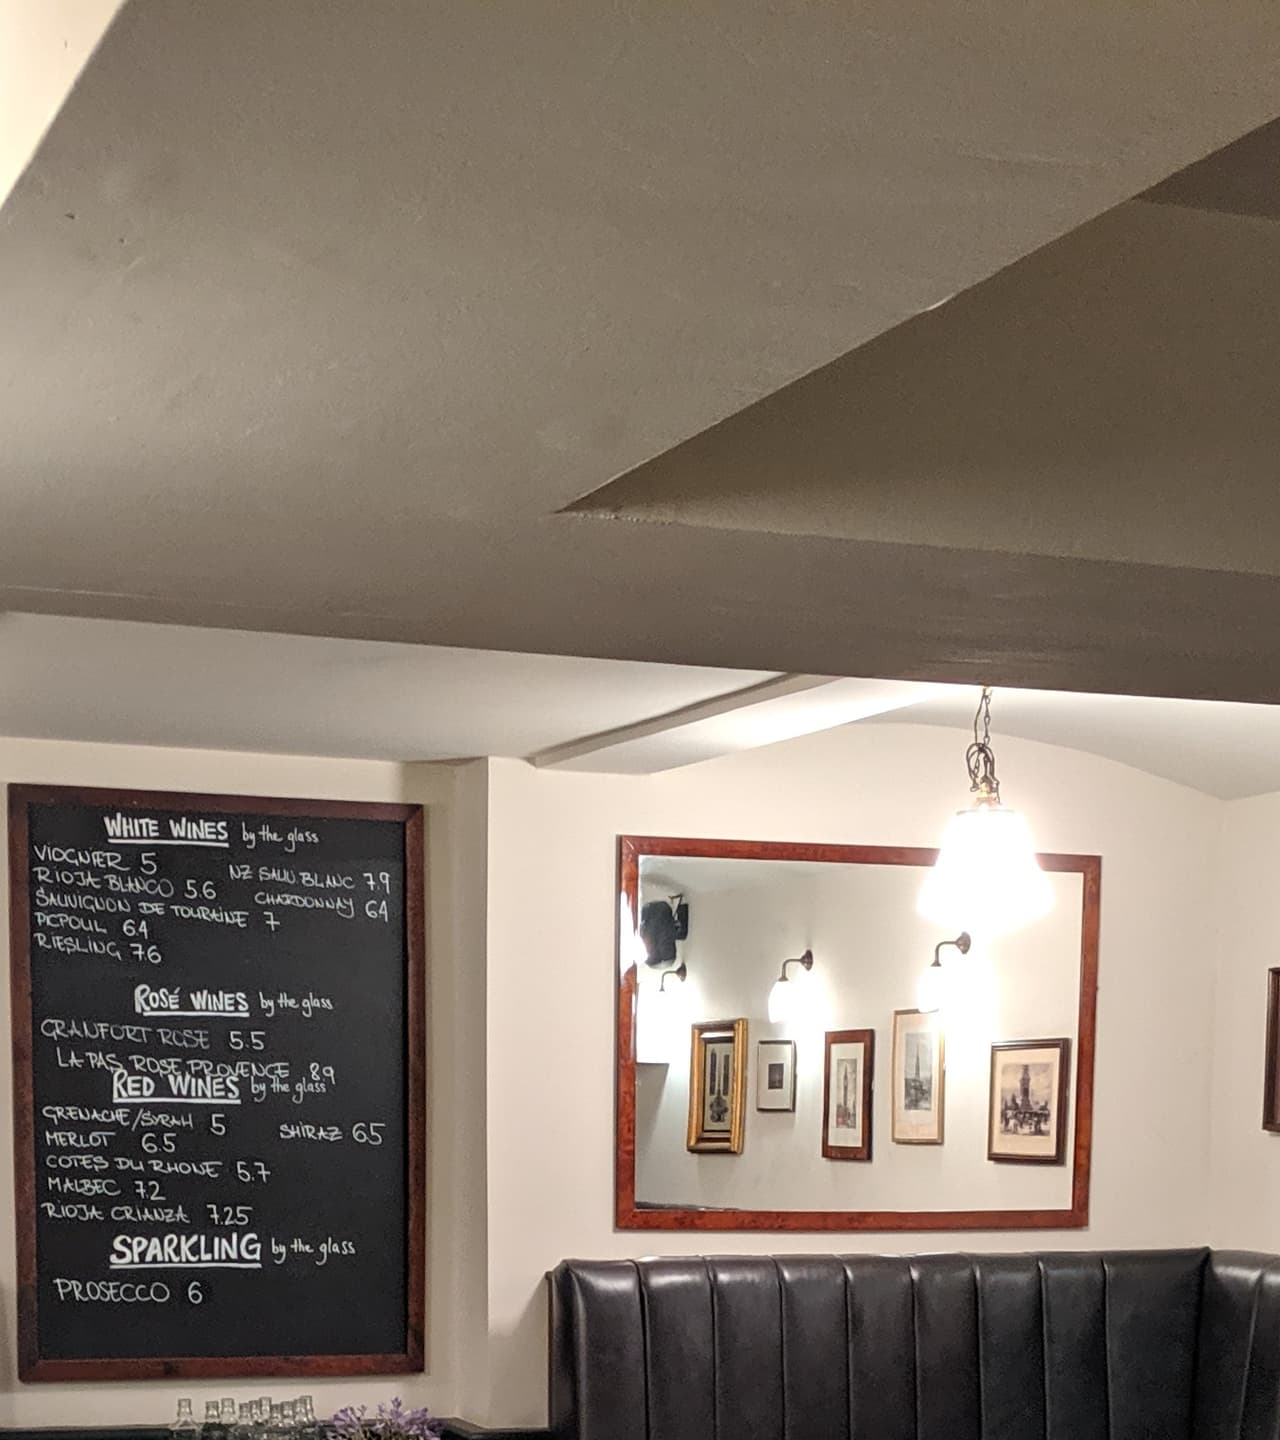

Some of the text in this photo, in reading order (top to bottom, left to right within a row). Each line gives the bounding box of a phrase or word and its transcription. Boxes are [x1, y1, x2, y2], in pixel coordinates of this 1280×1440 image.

[104, 813, 319, 852] WHITE WINES by the glass
[140, 852, 157, 875] 5
[32, 866, 217, 900] RIOJA BLANCO 5.6
[229, 864, 253, 880] NZ
[299, 872, 355, 889] BLANC
[363, 871, 391, 895] 7.9
[35, 887, 281, 932] SAUVIGNON DE TOURAINE 7
[254, 891, 354, 919] CHARDONNAY
[33, 932, 162, 965] RIESLING 7.6
[134, 983, 334, 1018] ROSÉ WINES by the glass
[40, 1018, 266, 1050] GRANFORT ROSE 5.5
[56, 1046, 85, 1069] LA
[129, 1054, 182, 1077] ROSE
[186, 1058, 290, 1079] PROVENCE
[113, 1069, 327, 1105] RED WINES by the glass
[209, 1113, 227, 1136] 5
[279, 1120, 344, 1142] SHIRAZ
[45, 1130, 177, 1154] MERLOT 6.5
[45, 1154, 272, 1183] COTES DU RHONE 5.7
[47, 1176, 167, 1201] MALBEC 7.2
[40, 1199, 254, 1226] RIOJA CRIANZA 7.25
[109, 1232, 356, 1266] SPARKLING by the glass
[52, 1277, 204, 1304] PROSECCO 6
